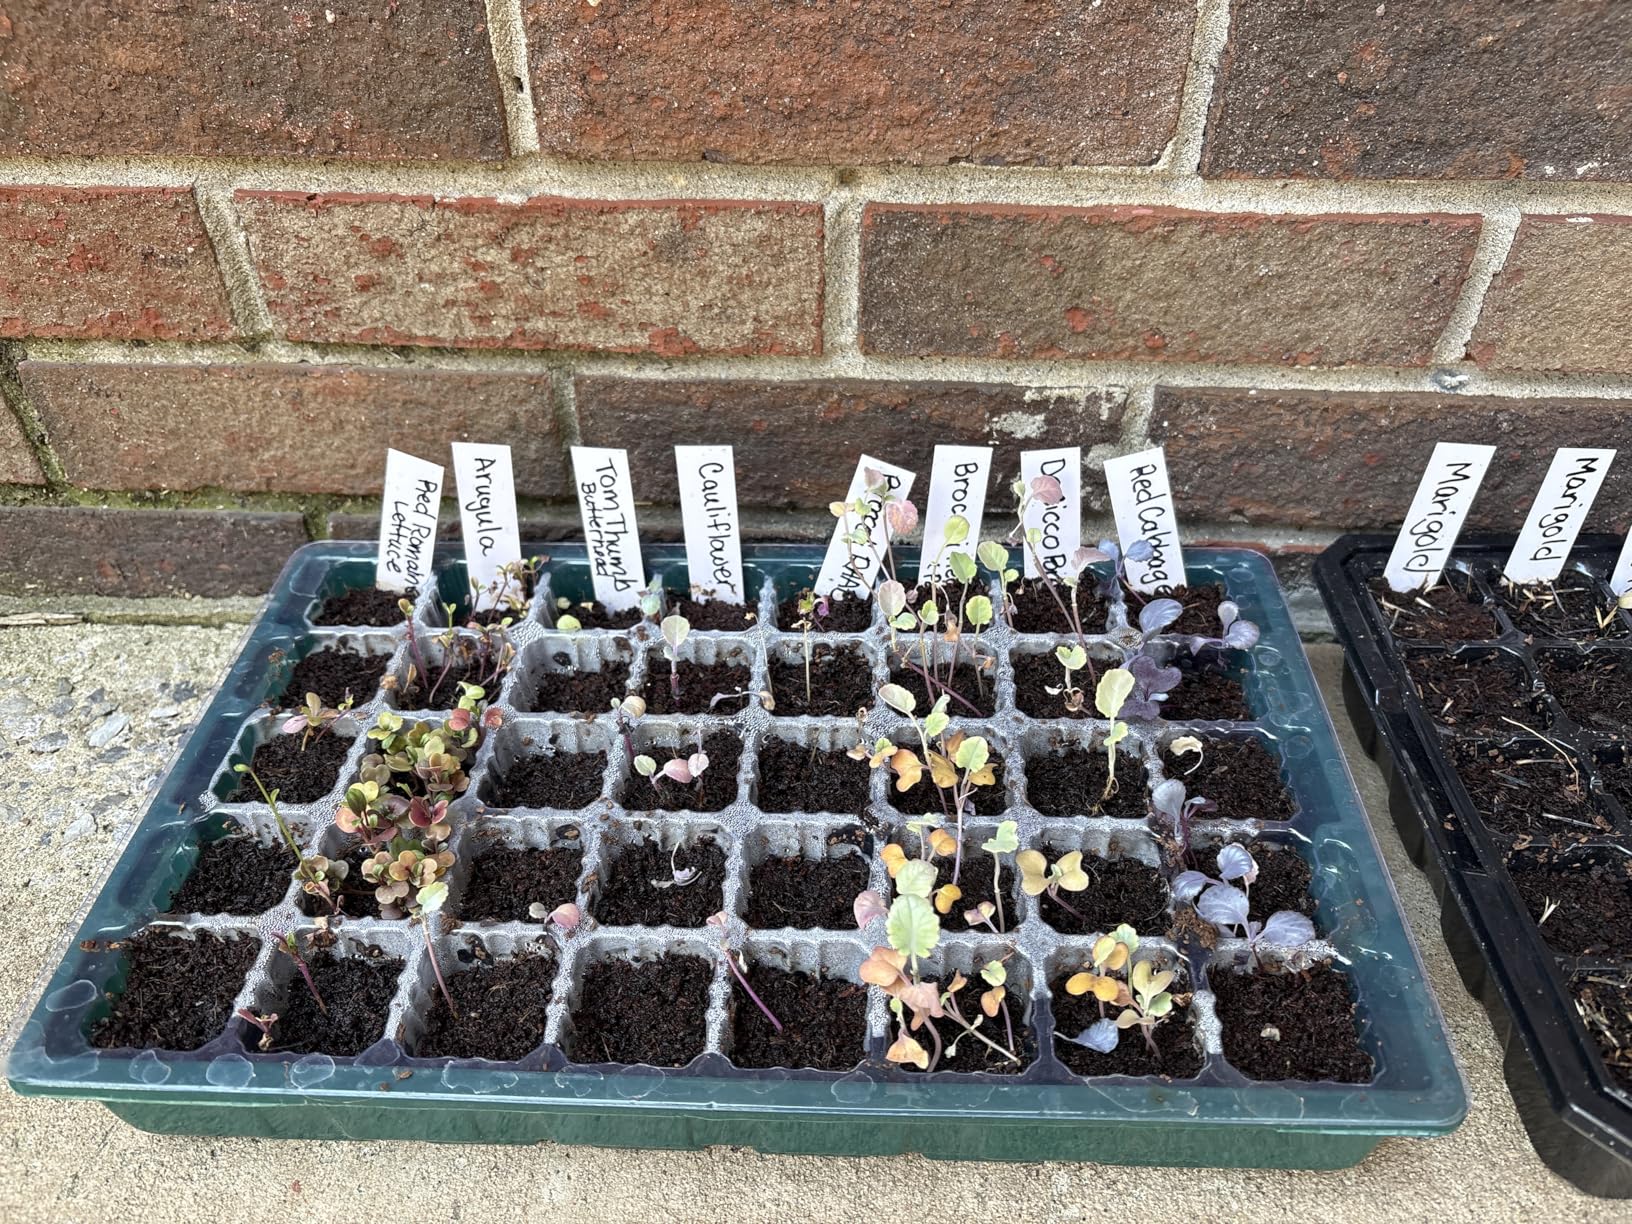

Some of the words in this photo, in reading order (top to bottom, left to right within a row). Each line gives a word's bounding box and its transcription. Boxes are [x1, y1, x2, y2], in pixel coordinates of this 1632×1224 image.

[412, 479, 438, 520] Red
[465, 457, 503, 557] Arugula
[596, 458, 620, 511] Tom
[951, 462, 979, 547] Broci
[1042, 495, 1067, 550] icco
[1130, 464, 1167, 506] Red
[1402, 462, 1473, 573] Marigold
[1529, 457, 1600, 561] Marigold
[386, 501, 412, 573] Lettuce
[581, 482, 611, 577] Butterhead
[604, 512, 638, 592] Thumb
[698, 462, 737, 594] Cauliflower
[1138, 505, 1174, 597] Cabbage
